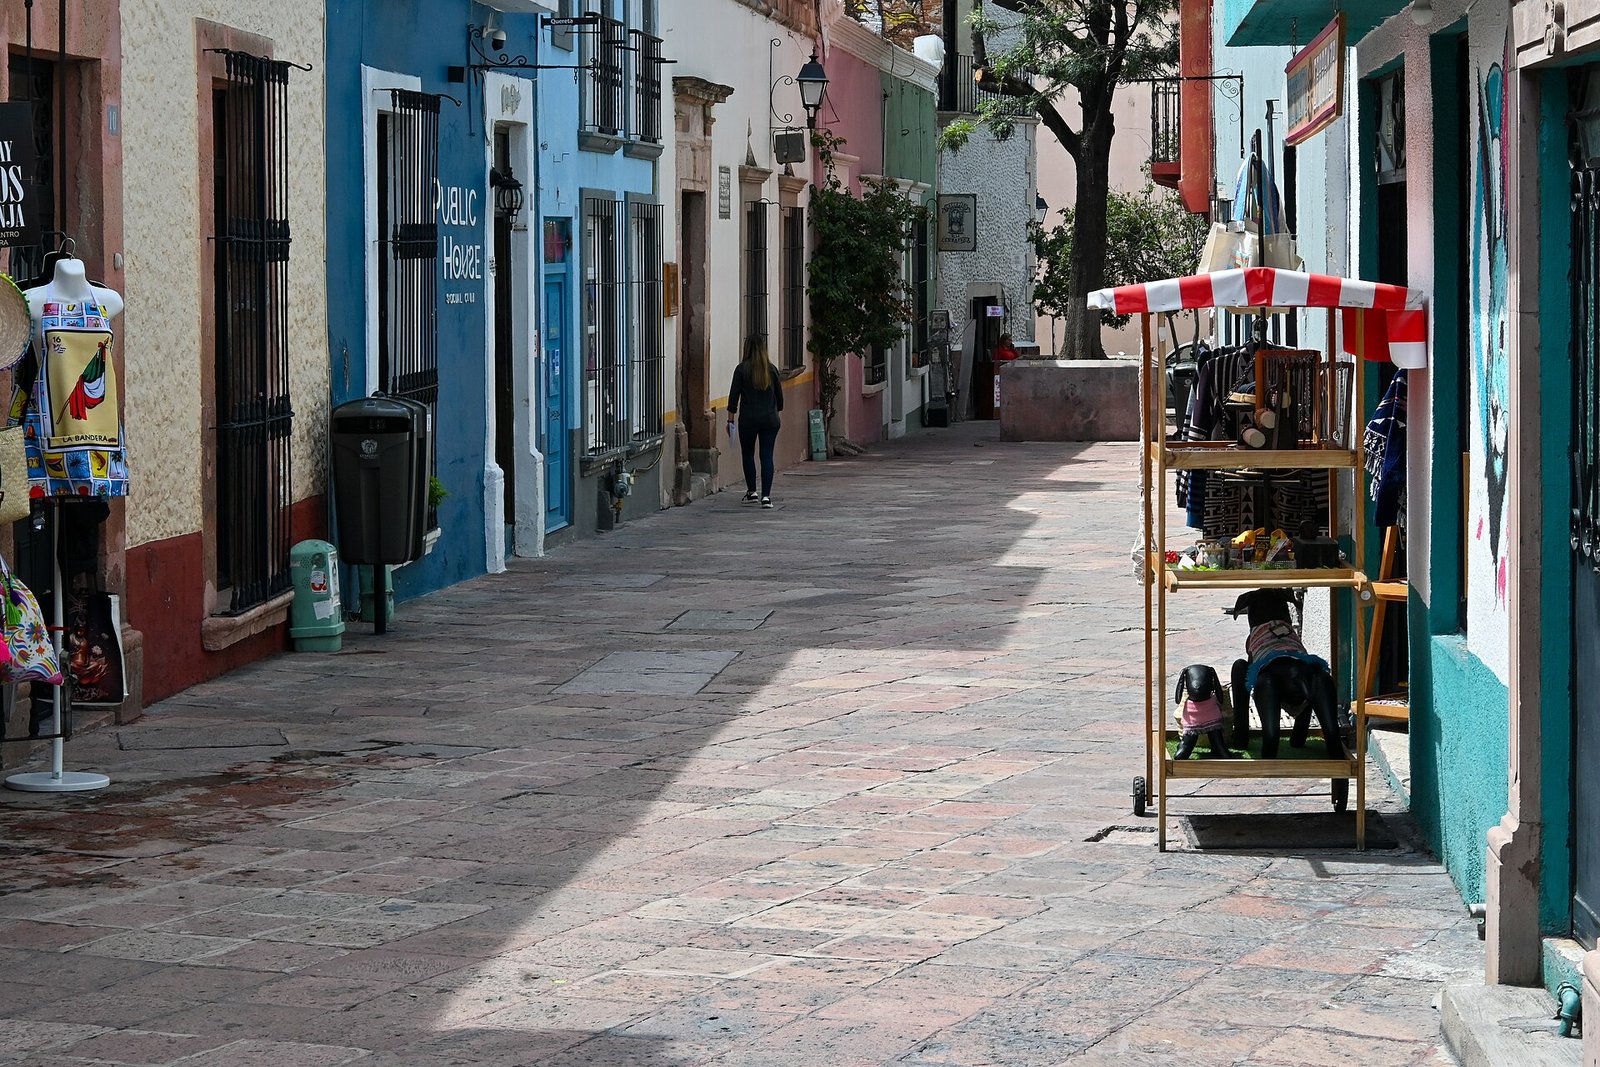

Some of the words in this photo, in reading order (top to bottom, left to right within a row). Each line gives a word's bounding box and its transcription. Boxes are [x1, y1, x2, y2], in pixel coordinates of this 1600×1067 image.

[109, 112, 116, 130] 10
[432, 177, 477, 227] PUBLIC
[63, 435, 72, 443] LA
[75, 434, 108, 443] BANDERA
